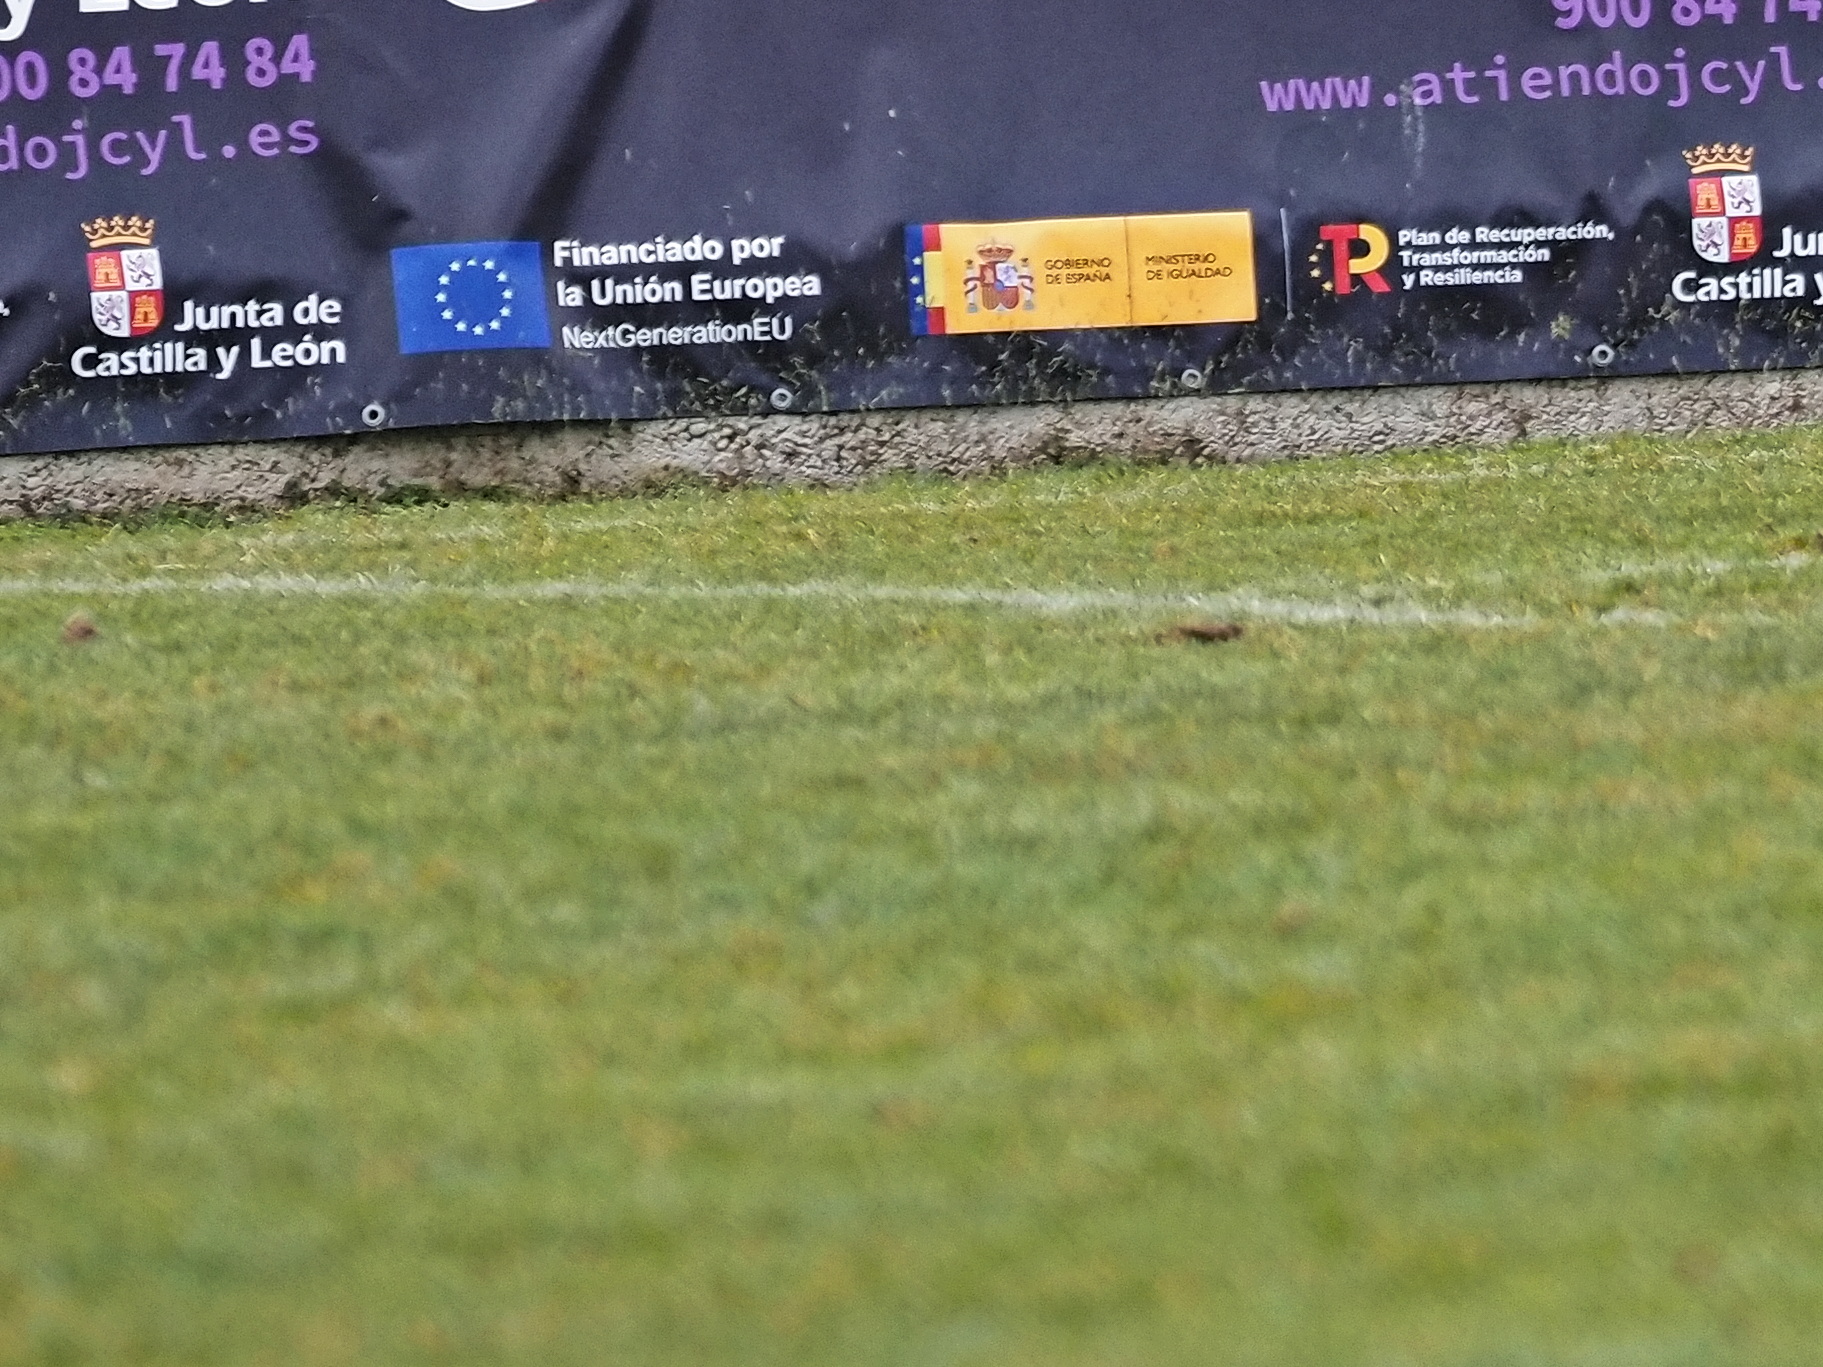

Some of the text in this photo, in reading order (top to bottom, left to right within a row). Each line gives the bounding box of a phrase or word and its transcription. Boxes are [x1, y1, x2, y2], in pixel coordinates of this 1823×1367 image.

[68, 46, 136, 98] 84
[155, 40, 226, 93] 74
[245, 34, 316, 88] 84
[1398, 221, 1615, 246] Plan de Recuperación,
[553, 235, 786, 268] Financiado por
[1044, 257, 1112, 270] GOBIERNO
[1145, 253, 1217, 266] MINISTERIO
[1399, 244, 1551, 267] Transformación
[1045, 270, 1112, 284] DE ESPAÑA
[1146, 266, 1233, 280] DE IGUALDAD
[1401, 266, 1523, 290] y Resiliencia
[1671, 267, 1805, 303] Castilla
[556, 273, 822, 307] la Unión Europea
[173, 293, 342, 332] Junta de
[561, 315, 793, 349] NextGenerationEU
[71, 334, 347, 380] Castilla y León
